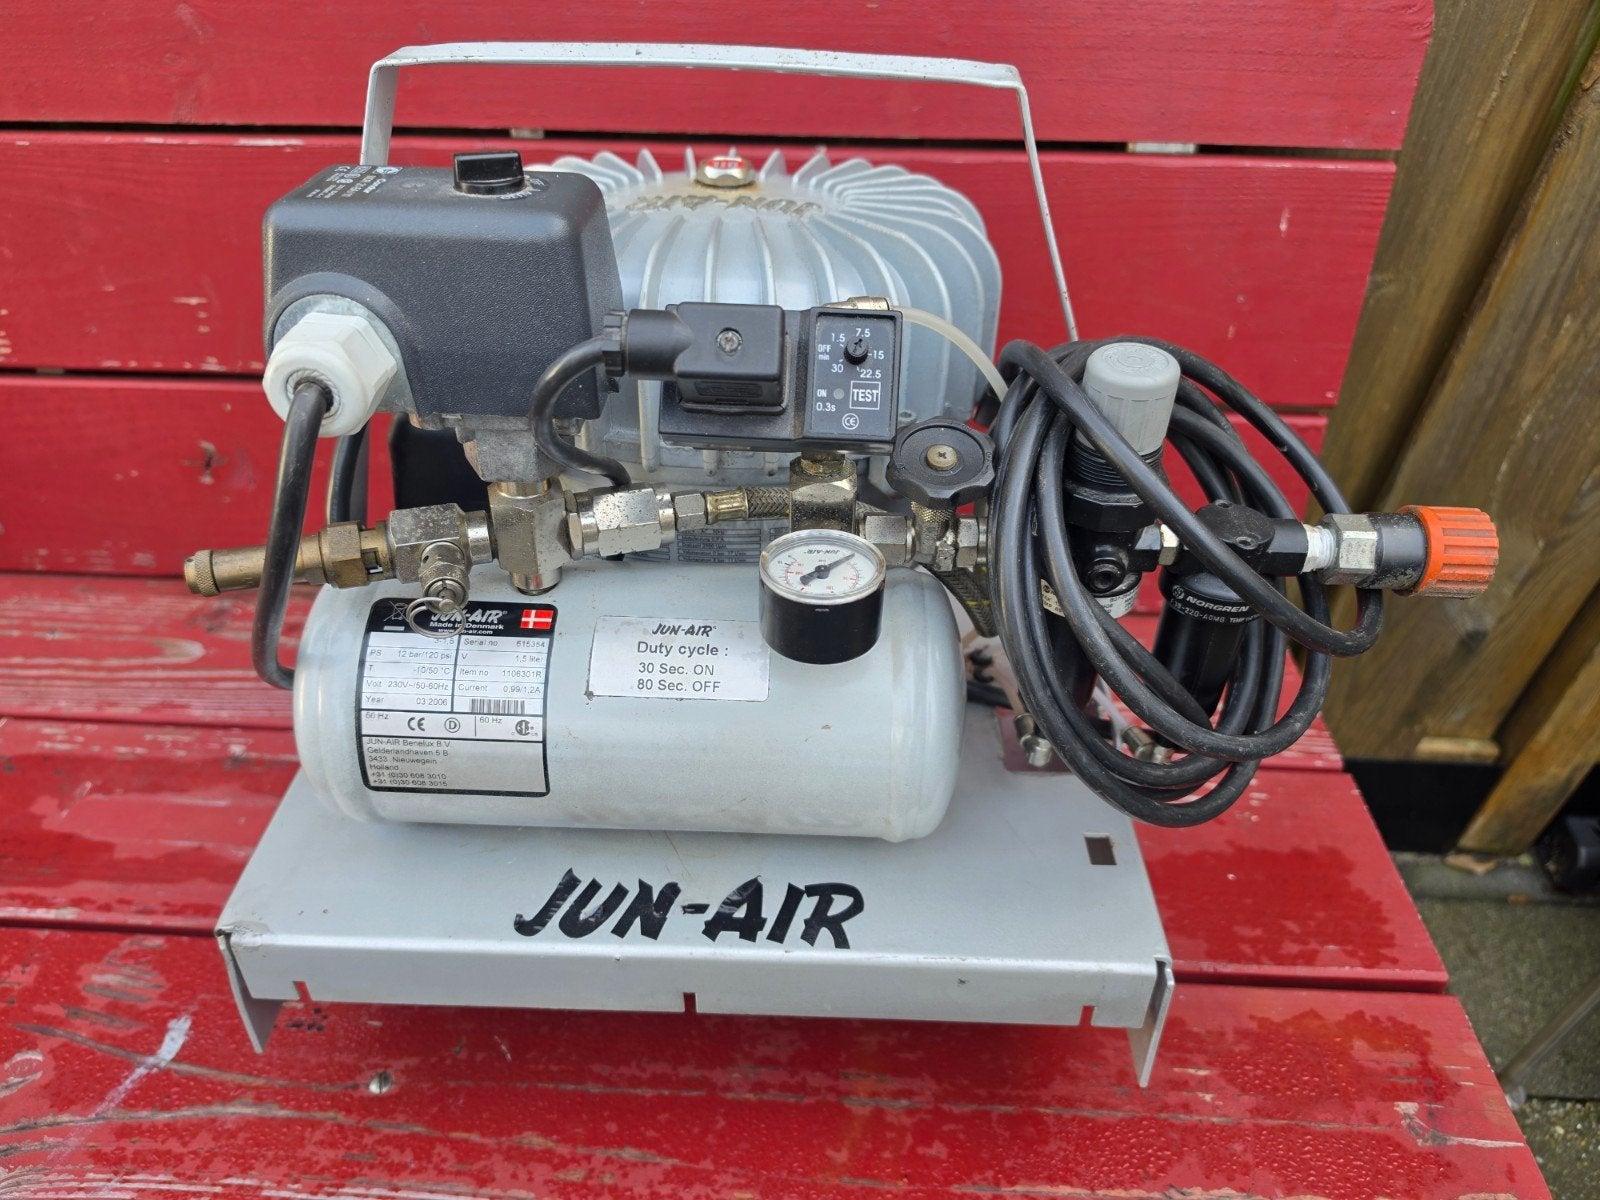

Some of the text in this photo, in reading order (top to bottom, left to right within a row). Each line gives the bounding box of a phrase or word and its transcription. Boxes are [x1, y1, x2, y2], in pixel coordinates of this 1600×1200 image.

[831, 333, 845, 342] 1.5
[855, 327, 871, 338] 7.5
[818, 344, 831, 352] OFF
[831, 363, 844, 373] 30
[860, 369, 881, 378] 22.5
[817, 389, 827, 397] ON
[852, 389, 879, 402] TEST
[816, 402, 836, 412] 0.3s
[1186, 596, 1250, 613] NORGREN
[464, 638, 486, 646] Serial
[370, 649, 382, 657] PS
[408, 650, 438, 659] bar/120
[440, 652, 452, 660] psi
[637, 641, 673, 657] Duty
[678, 644, 719, 658] cycle
[529, 655, 543, 663] liter
[638, 662, 714, 676] 30 Sec. ON
[458, 683, 488, 691] Current
[637, 678, 720, 693] 80 Sec. OFF
[365, 695, 384, 703] Year
[407, 716, 426, 731] CE
[402, 739, 434, 747] Benelux
[392, 757, 437, 765] Nieuwegein
[514, 867, 865, 949] JUN-AIR
